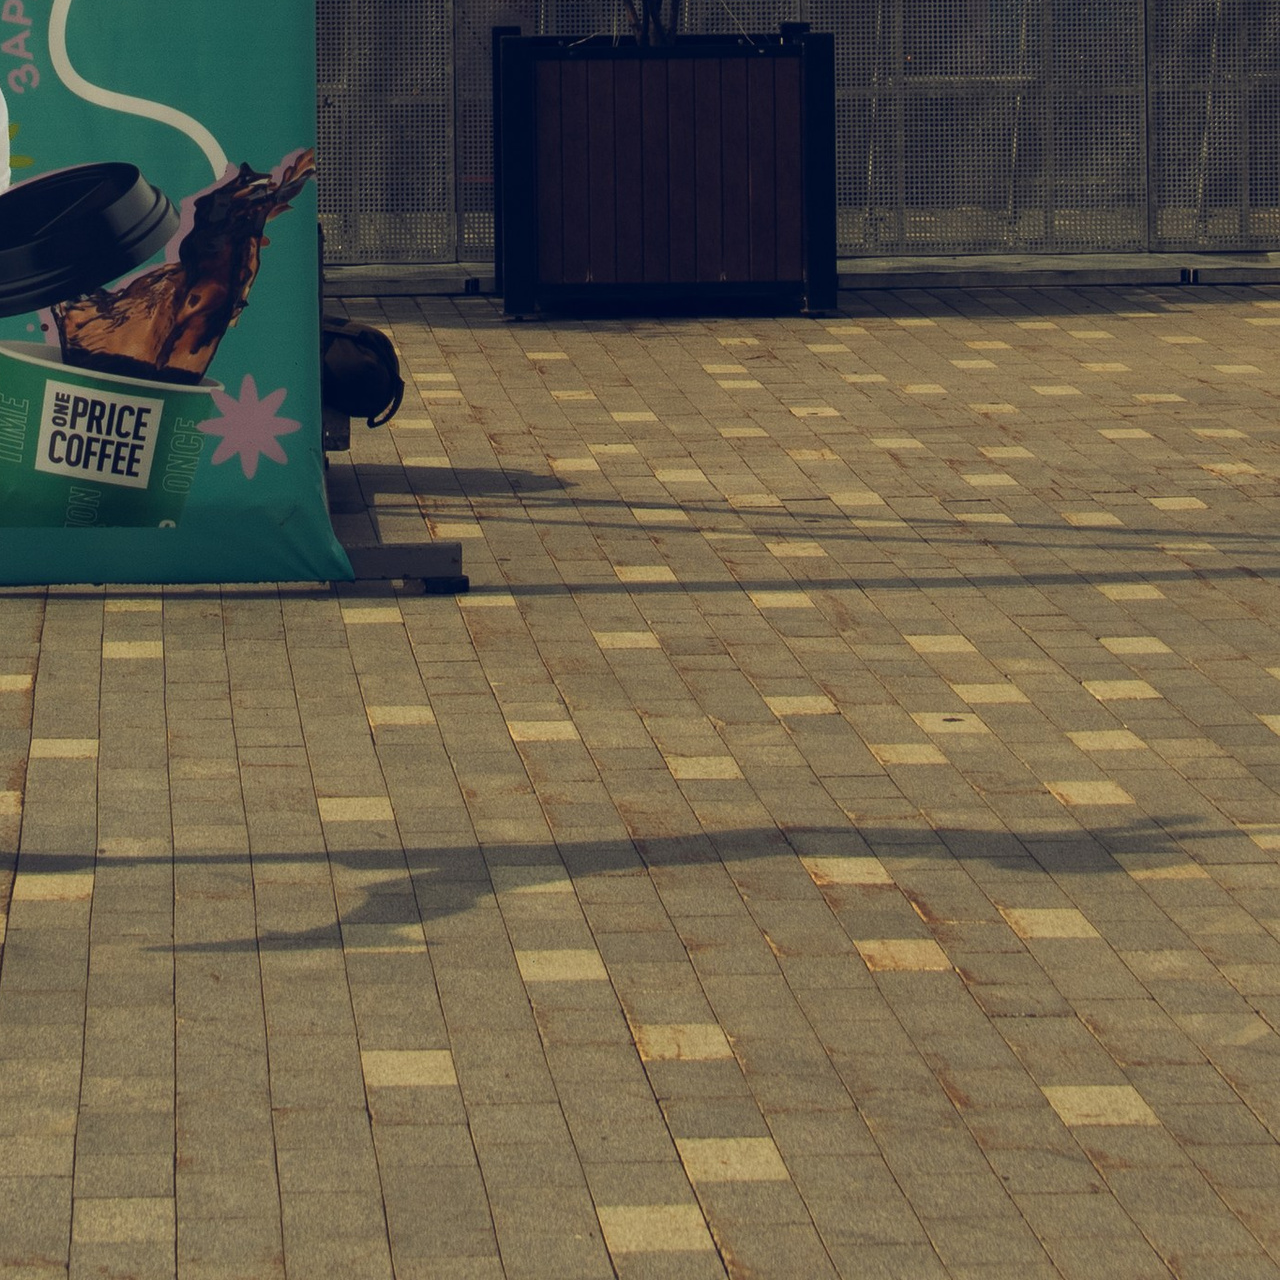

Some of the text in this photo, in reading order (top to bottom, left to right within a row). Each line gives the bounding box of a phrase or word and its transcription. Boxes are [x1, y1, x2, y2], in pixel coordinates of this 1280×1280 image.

[52, 392, 152, 441] ONE PRICE
[48, 430, 145, 477] COFFEE
